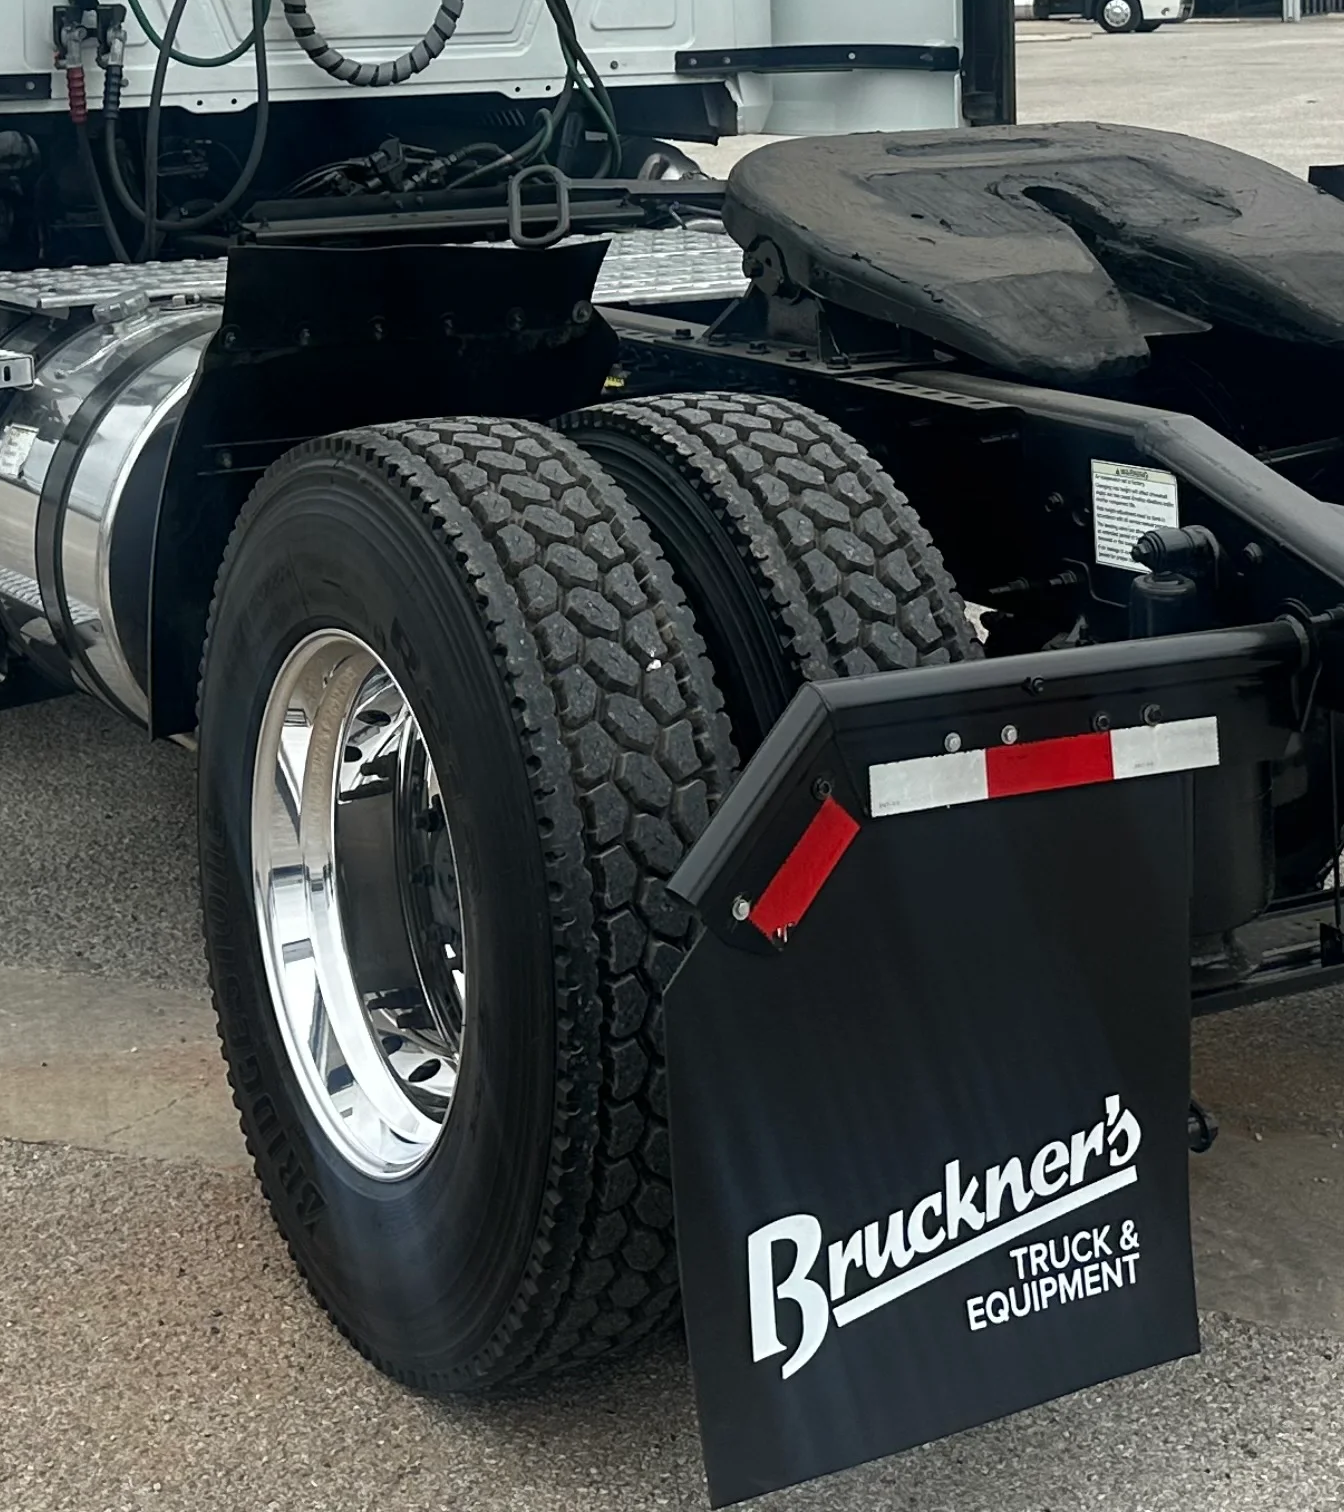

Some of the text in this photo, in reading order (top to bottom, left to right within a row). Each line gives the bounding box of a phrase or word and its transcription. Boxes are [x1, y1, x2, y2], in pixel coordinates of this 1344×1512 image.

[747, 1094, 1143, 1380] Bruckner's
[1009, 1220, 1140, 1281] TRUCK &
[967, 1252, 1140, 1332] EQUIPMENT
